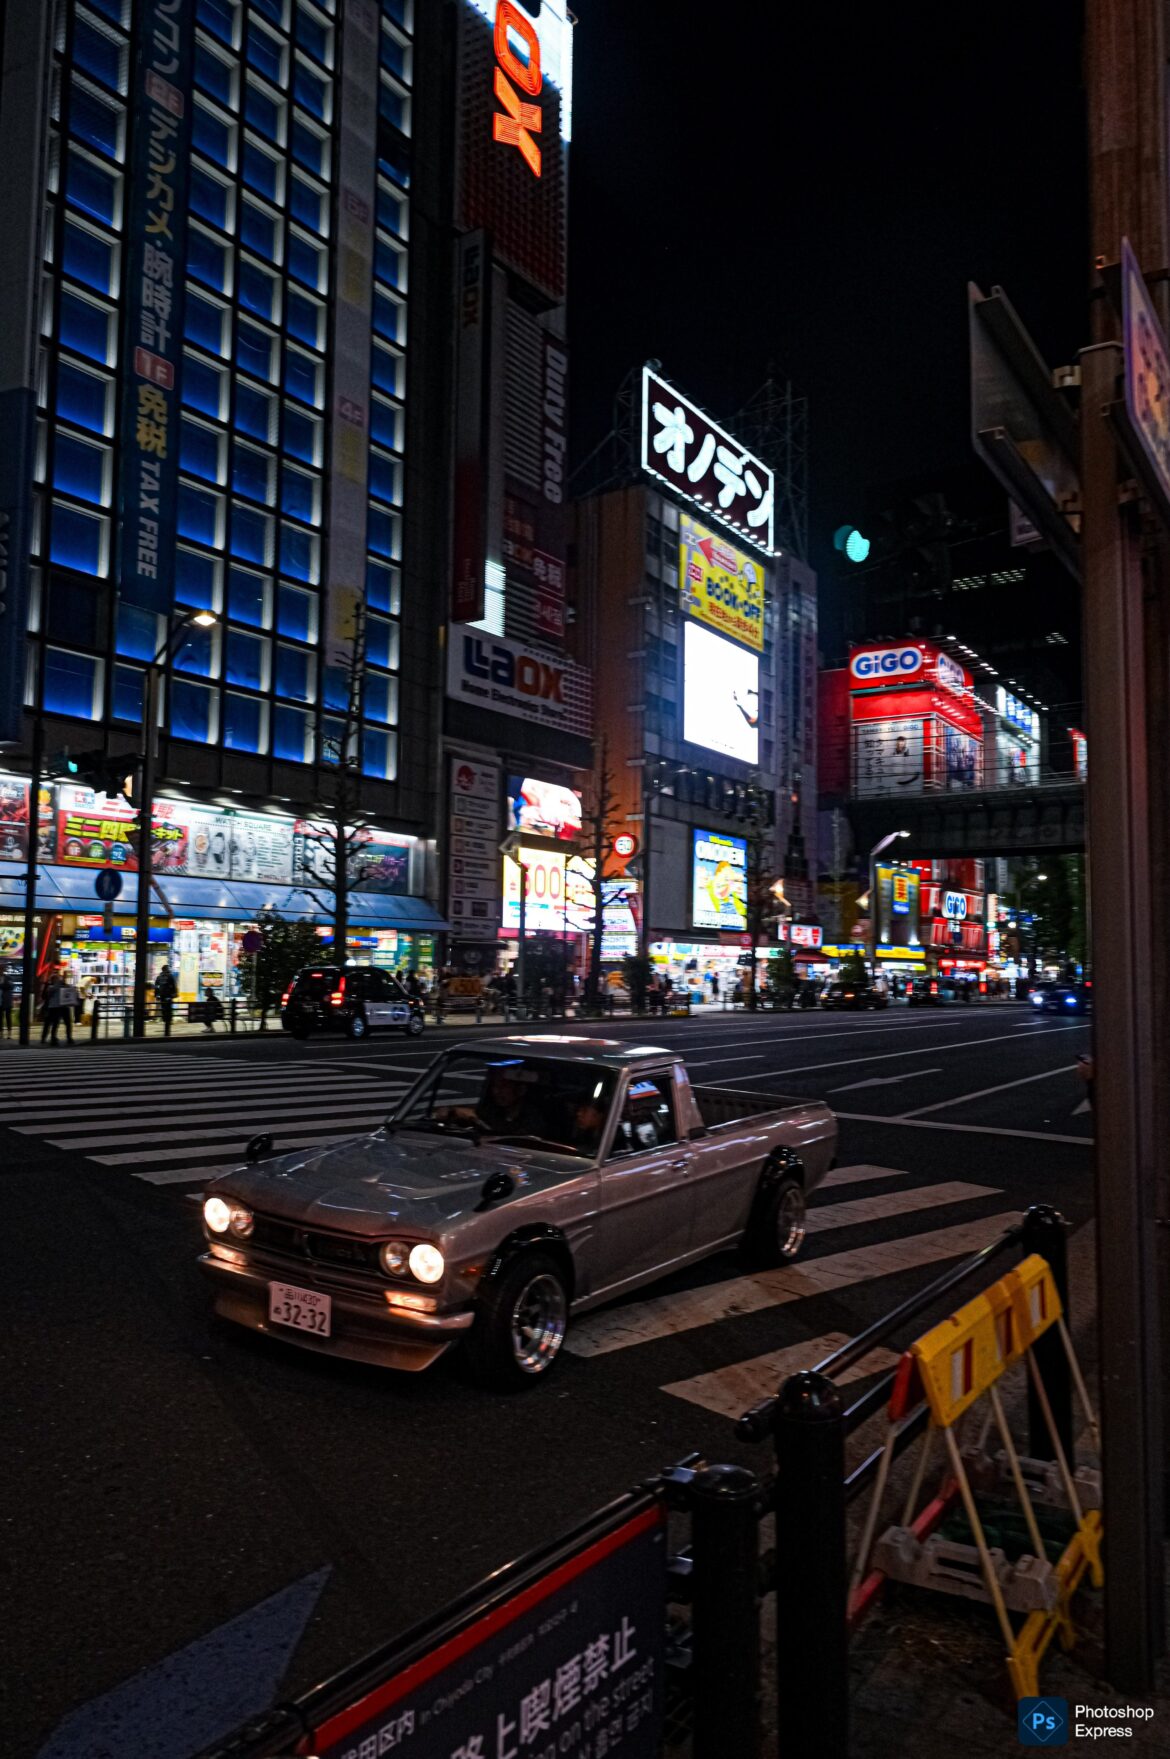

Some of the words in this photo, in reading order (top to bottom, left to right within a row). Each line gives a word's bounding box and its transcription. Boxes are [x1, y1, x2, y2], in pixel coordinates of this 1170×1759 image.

[137, 384, 168, 460] 免税
[545, 344, 568, 428] Duty
[138, 460, 160, 519] TAX
[544, 426, 567, 503] Free
[652, 401, 771, 526] オノデン
[136, 515, 160, 580] FREE
[855, 650, 919, 676] GiGO
[283, 1301, 327, 1333] 32-32
[583, 1696, 611, 1731] the
[612, 1655, 655, 1708] street
